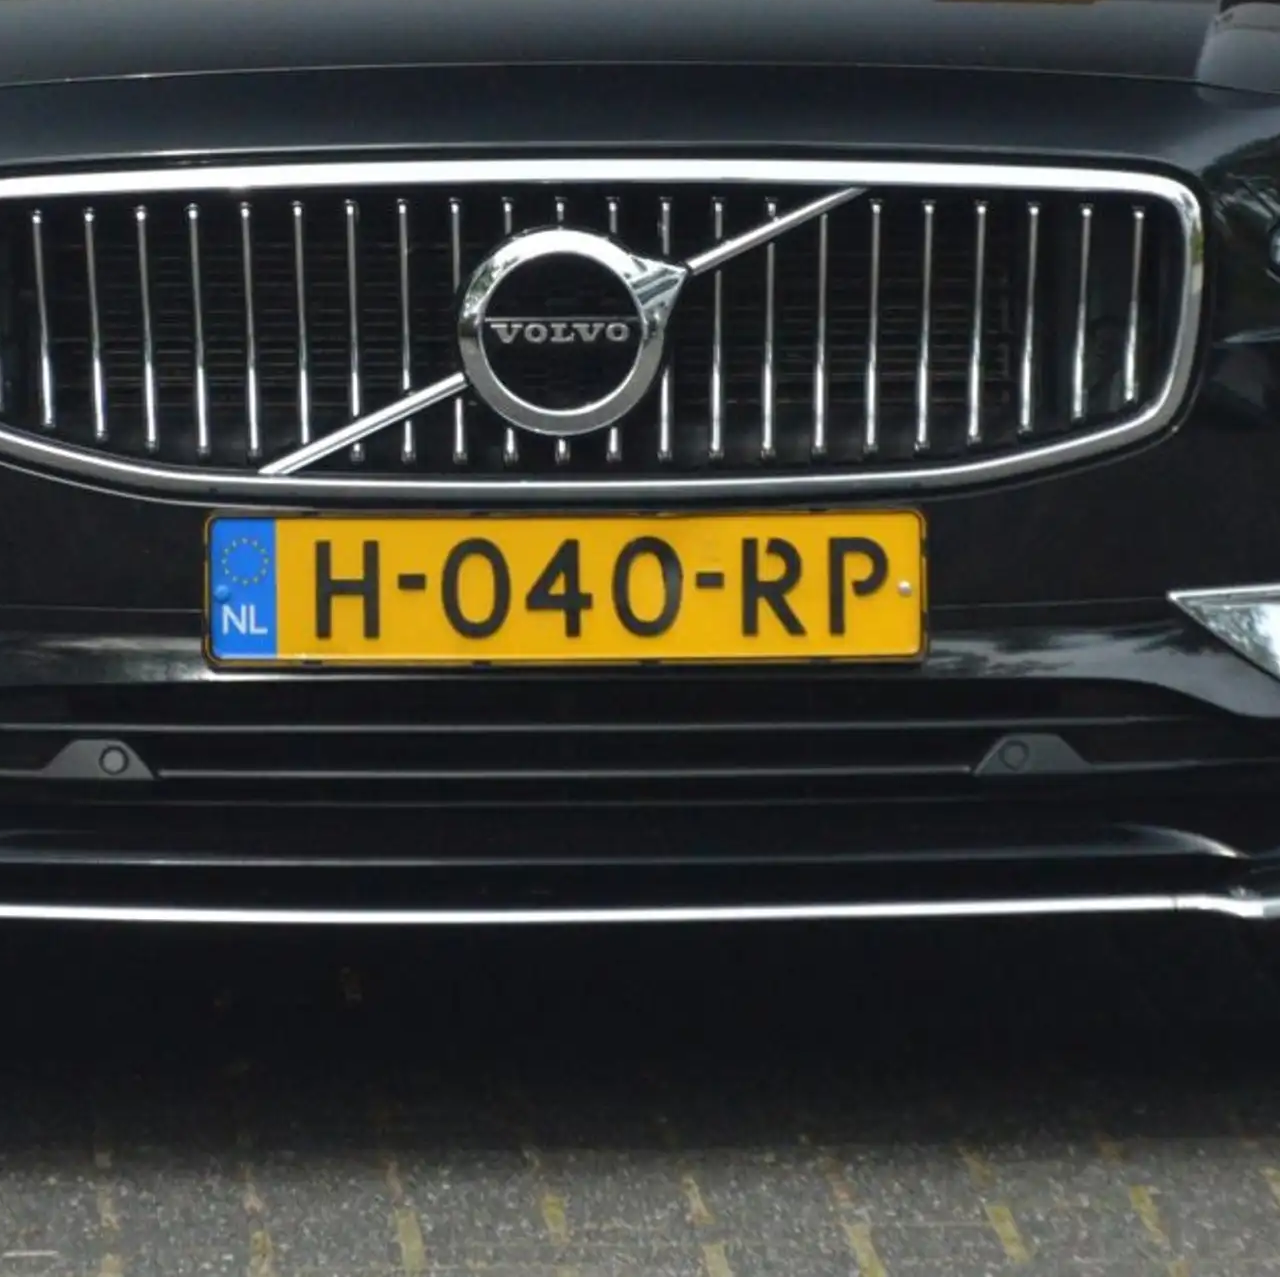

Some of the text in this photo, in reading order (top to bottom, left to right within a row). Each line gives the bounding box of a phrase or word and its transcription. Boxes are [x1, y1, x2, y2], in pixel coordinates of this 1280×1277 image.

[490, 323, 629, 344] VOLVO
[314, 536, 891, 639] H-040-RP
[222, 604, 269, 635] NL
